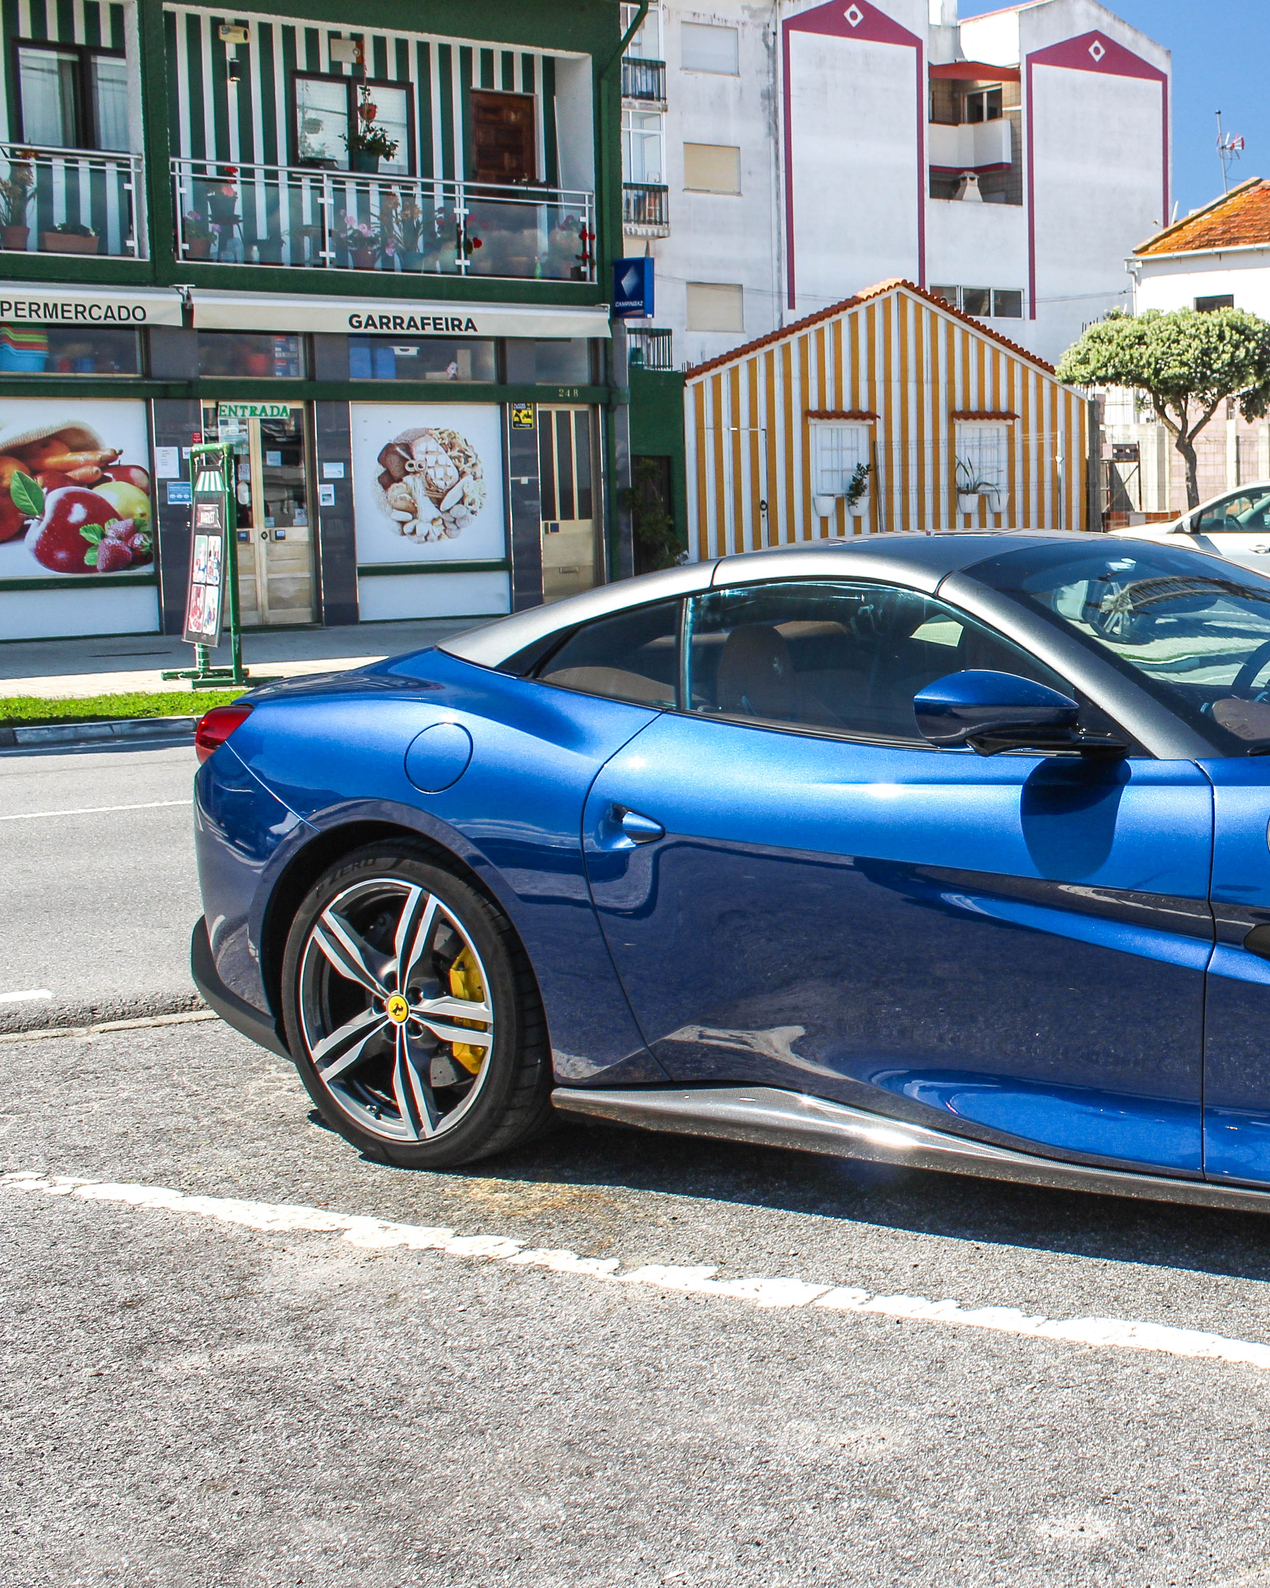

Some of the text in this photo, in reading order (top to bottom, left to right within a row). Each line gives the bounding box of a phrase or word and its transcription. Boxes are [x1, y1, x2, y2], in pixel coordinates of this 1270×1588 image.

[0, 300, 147, 322] PERMERCADO
[348, 313, 478, 332] GARRAFEIRA
[219, 404, 290, 417] ENTRADA
